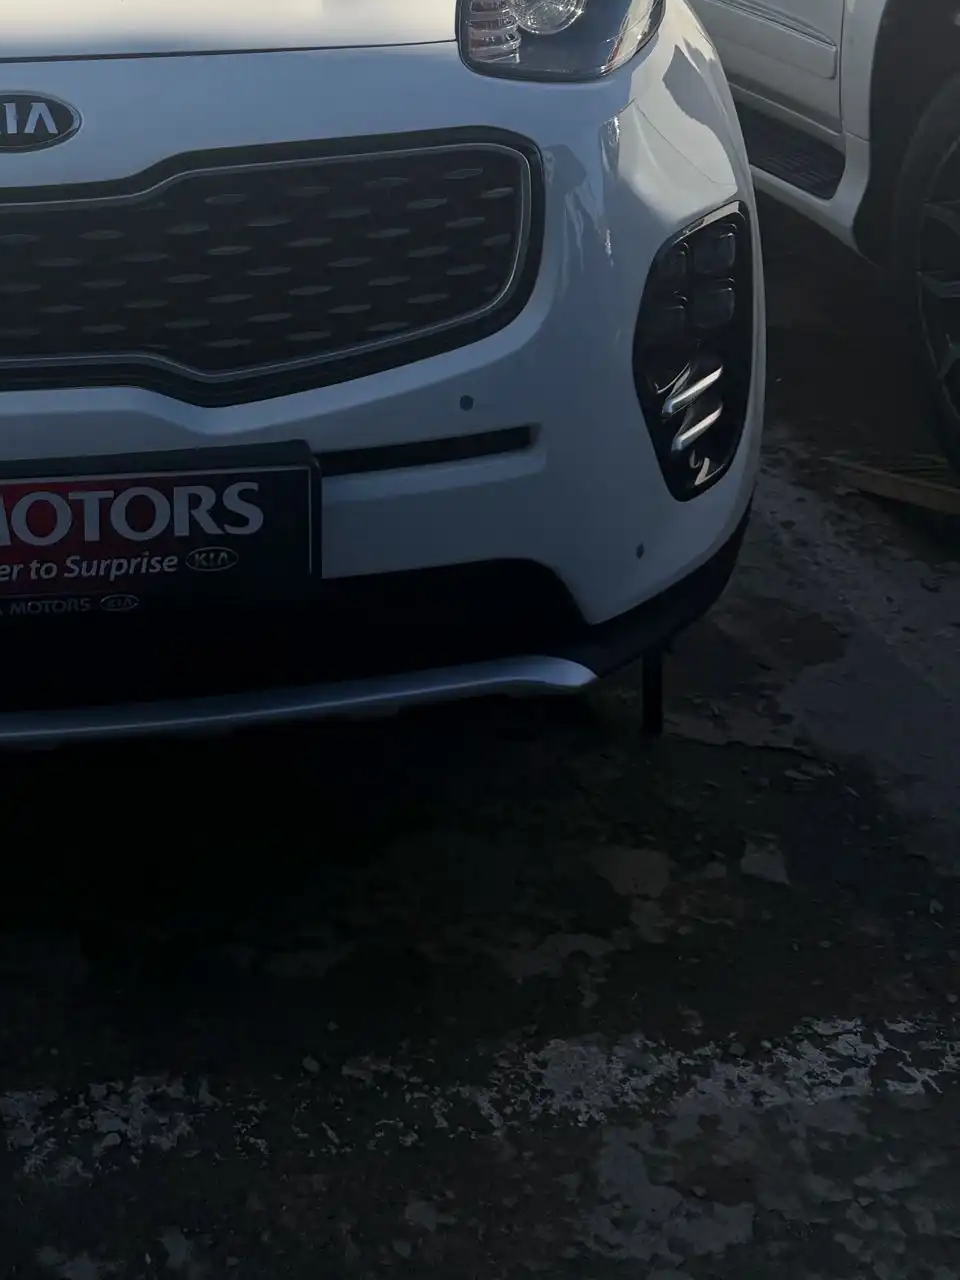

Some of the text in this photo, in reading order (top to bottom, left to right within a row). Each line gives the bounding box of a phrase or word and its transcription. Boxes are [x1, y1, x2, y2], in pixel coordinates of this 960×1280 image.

[29, 558, 57, 579] to
[63, 550, 178, 582] Surprise
[194, 552, 229, 567] KIA
[10, 597, 91, 615] MOTORS
